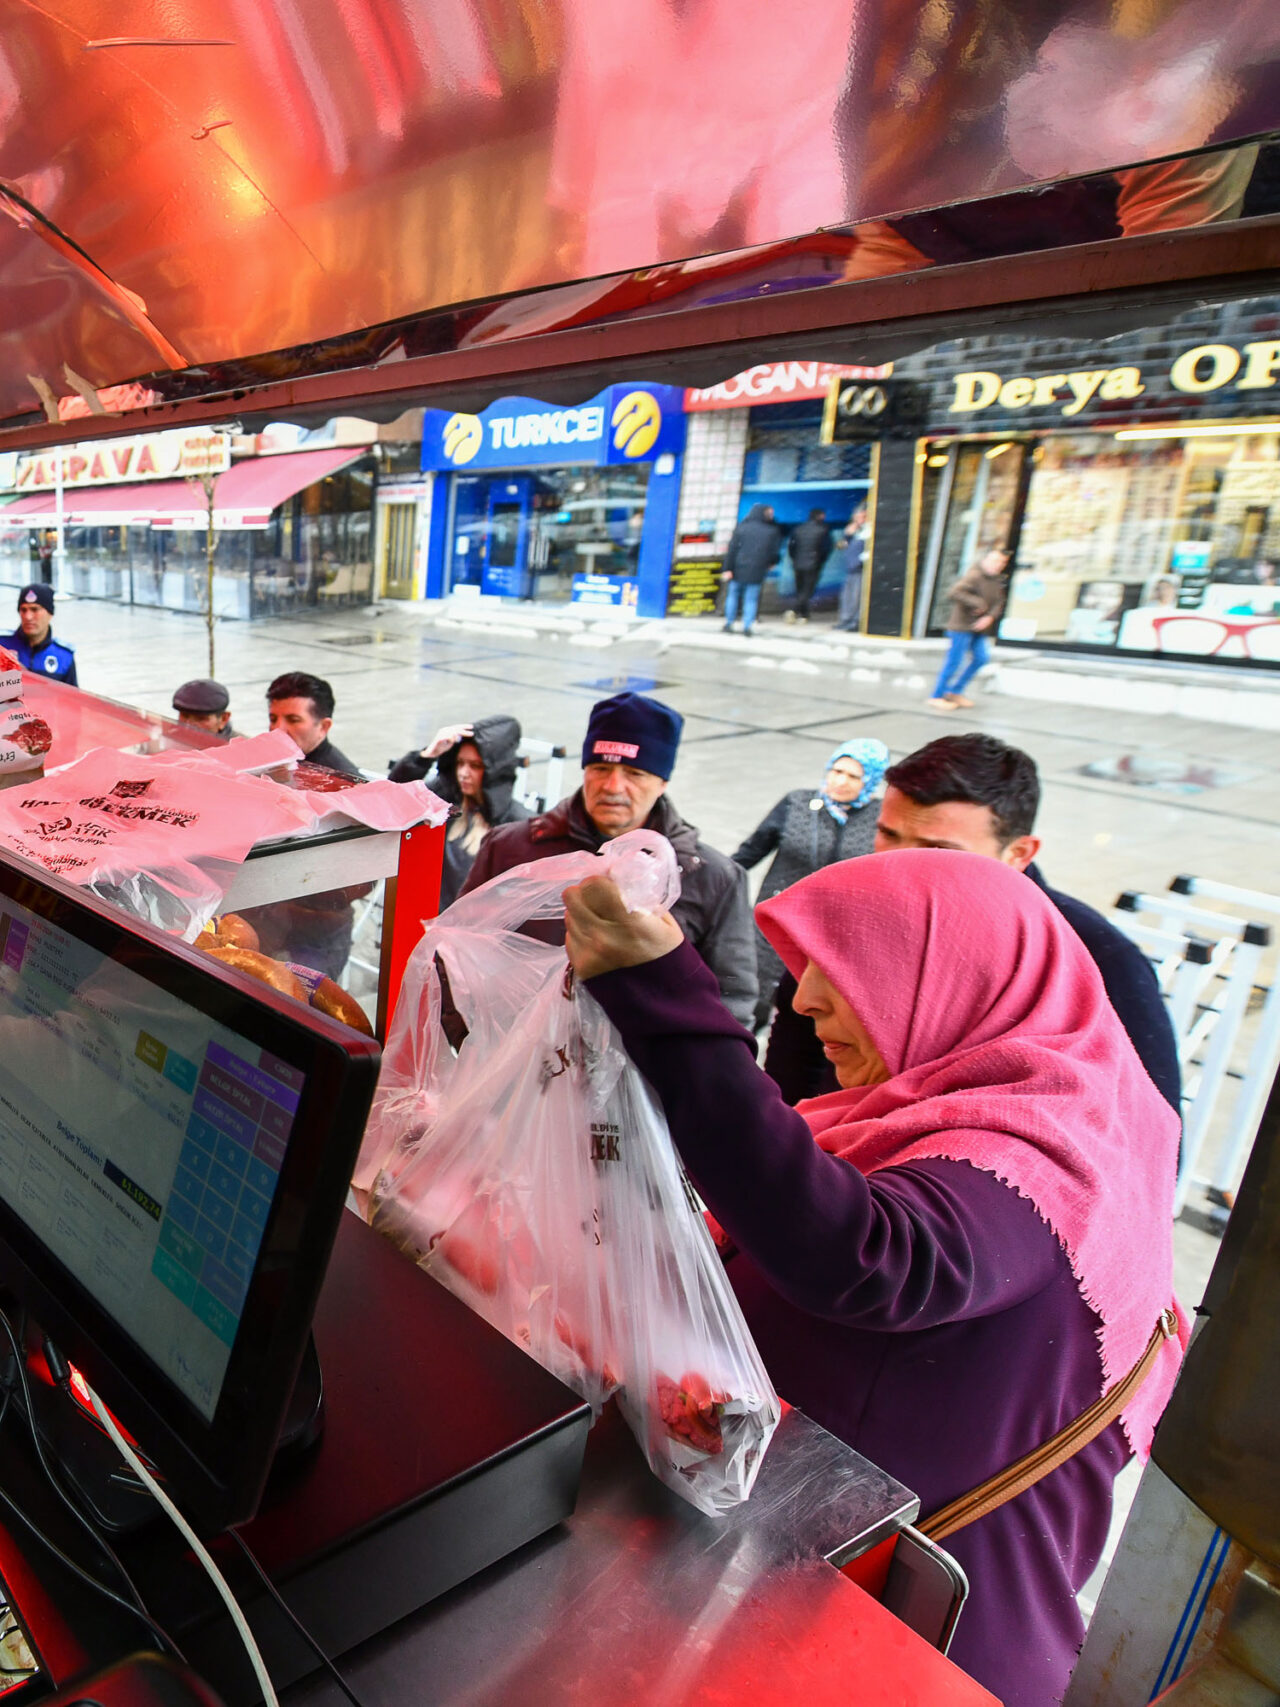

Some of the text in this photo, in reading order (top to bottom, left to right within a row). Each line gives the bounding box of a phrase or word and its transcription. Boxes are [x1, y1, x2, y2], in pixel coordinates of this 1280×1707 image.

[948, 366, 1146, 416] Derya
[55, 1119, 103, 1170] Belge Toplam:
